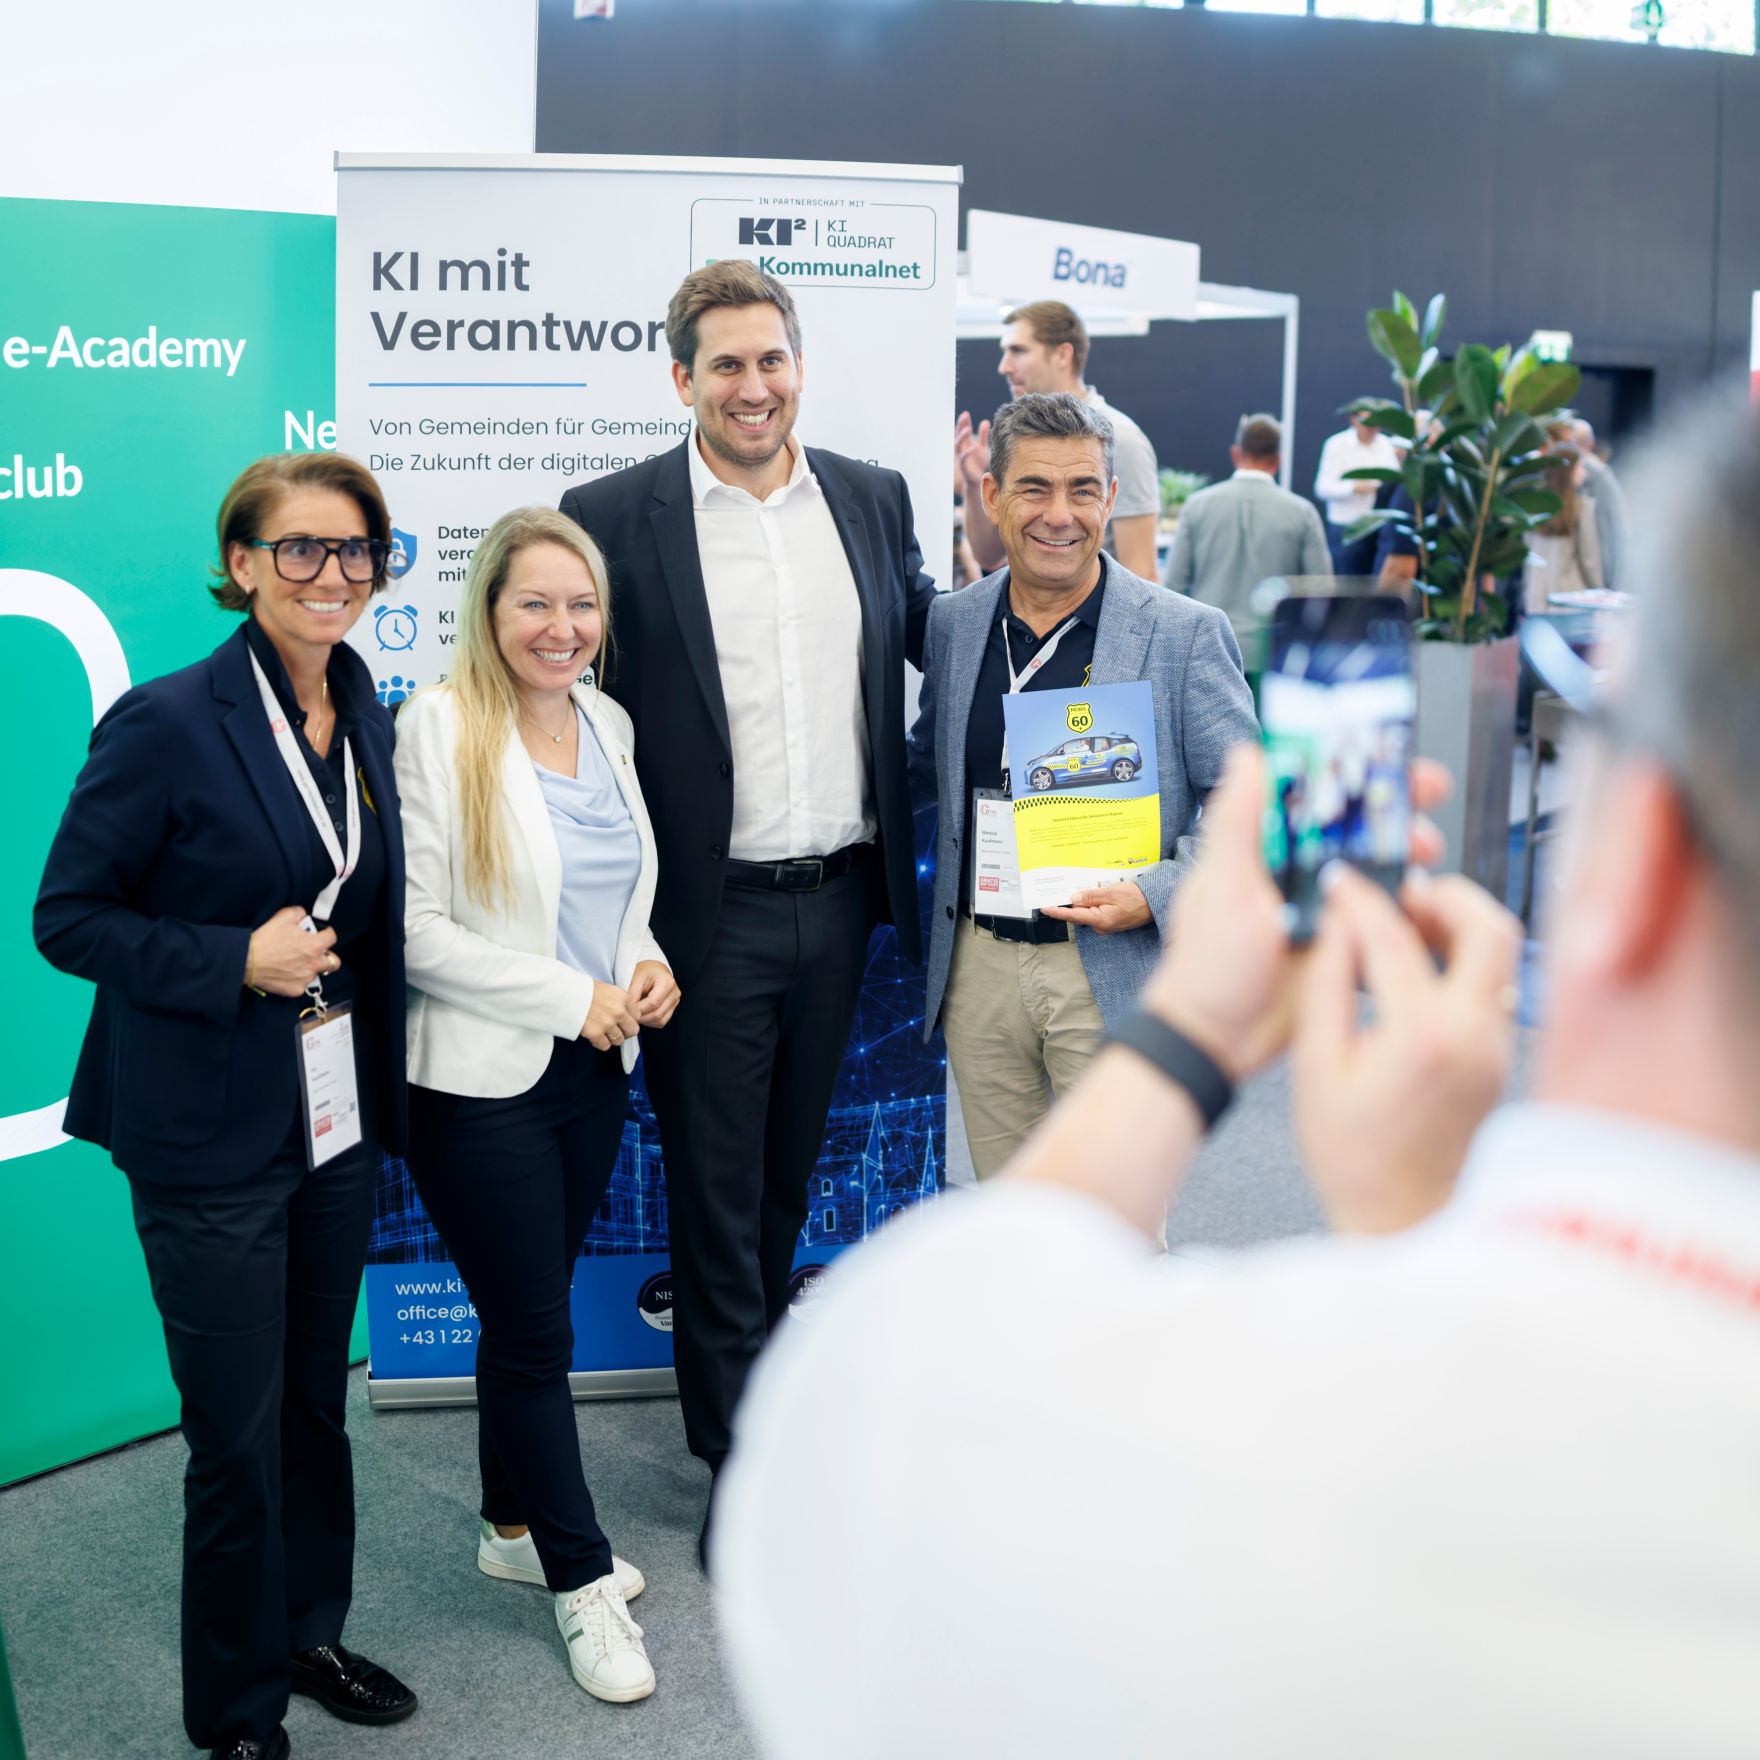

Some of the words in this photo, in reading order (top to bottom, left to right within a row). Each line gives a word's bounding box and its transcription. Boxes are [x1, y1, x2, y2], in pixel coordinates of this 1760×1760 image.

[759, 197, 769, 205] IN
[773, 198, 845, 208] PARTNERSCHAFT
[849, 200, 865, 208] MIT
[827, 219, 848, 233] KI
[827, 234, 895, 250] QUADRAT
[372, 251, 419, 291] KI
[438, 247, 530, 292] mit
[759, 256, 921, 279] Kommunalnet
[1053, 247, 1127, 288] Bona
[370, 311, 666, 352] Verantwor
[2, 325, 247, 377] e-Academy
[284, 410, 336, 450] Ne
[369, 418, 412, 435] Von
[419, 417, 548, 435] Gemeinden
[556, 418, 584, 435] für
[370, 453, 403, 471] Die
[410, 453, 492, 471] Zukunft
[498, 453, 535, 471] der
[541, 453, 637, 476] digitalen
[1071, 715, 1089, 727] 60
[803, 1276, 825, 1287] ISO
[397, 1303, 479, 1322] office@k
[400, 1329, 435, 1344] +43
[440, 1329, 446, 1344] 1
[451, 1329, 473, 1344] 22
